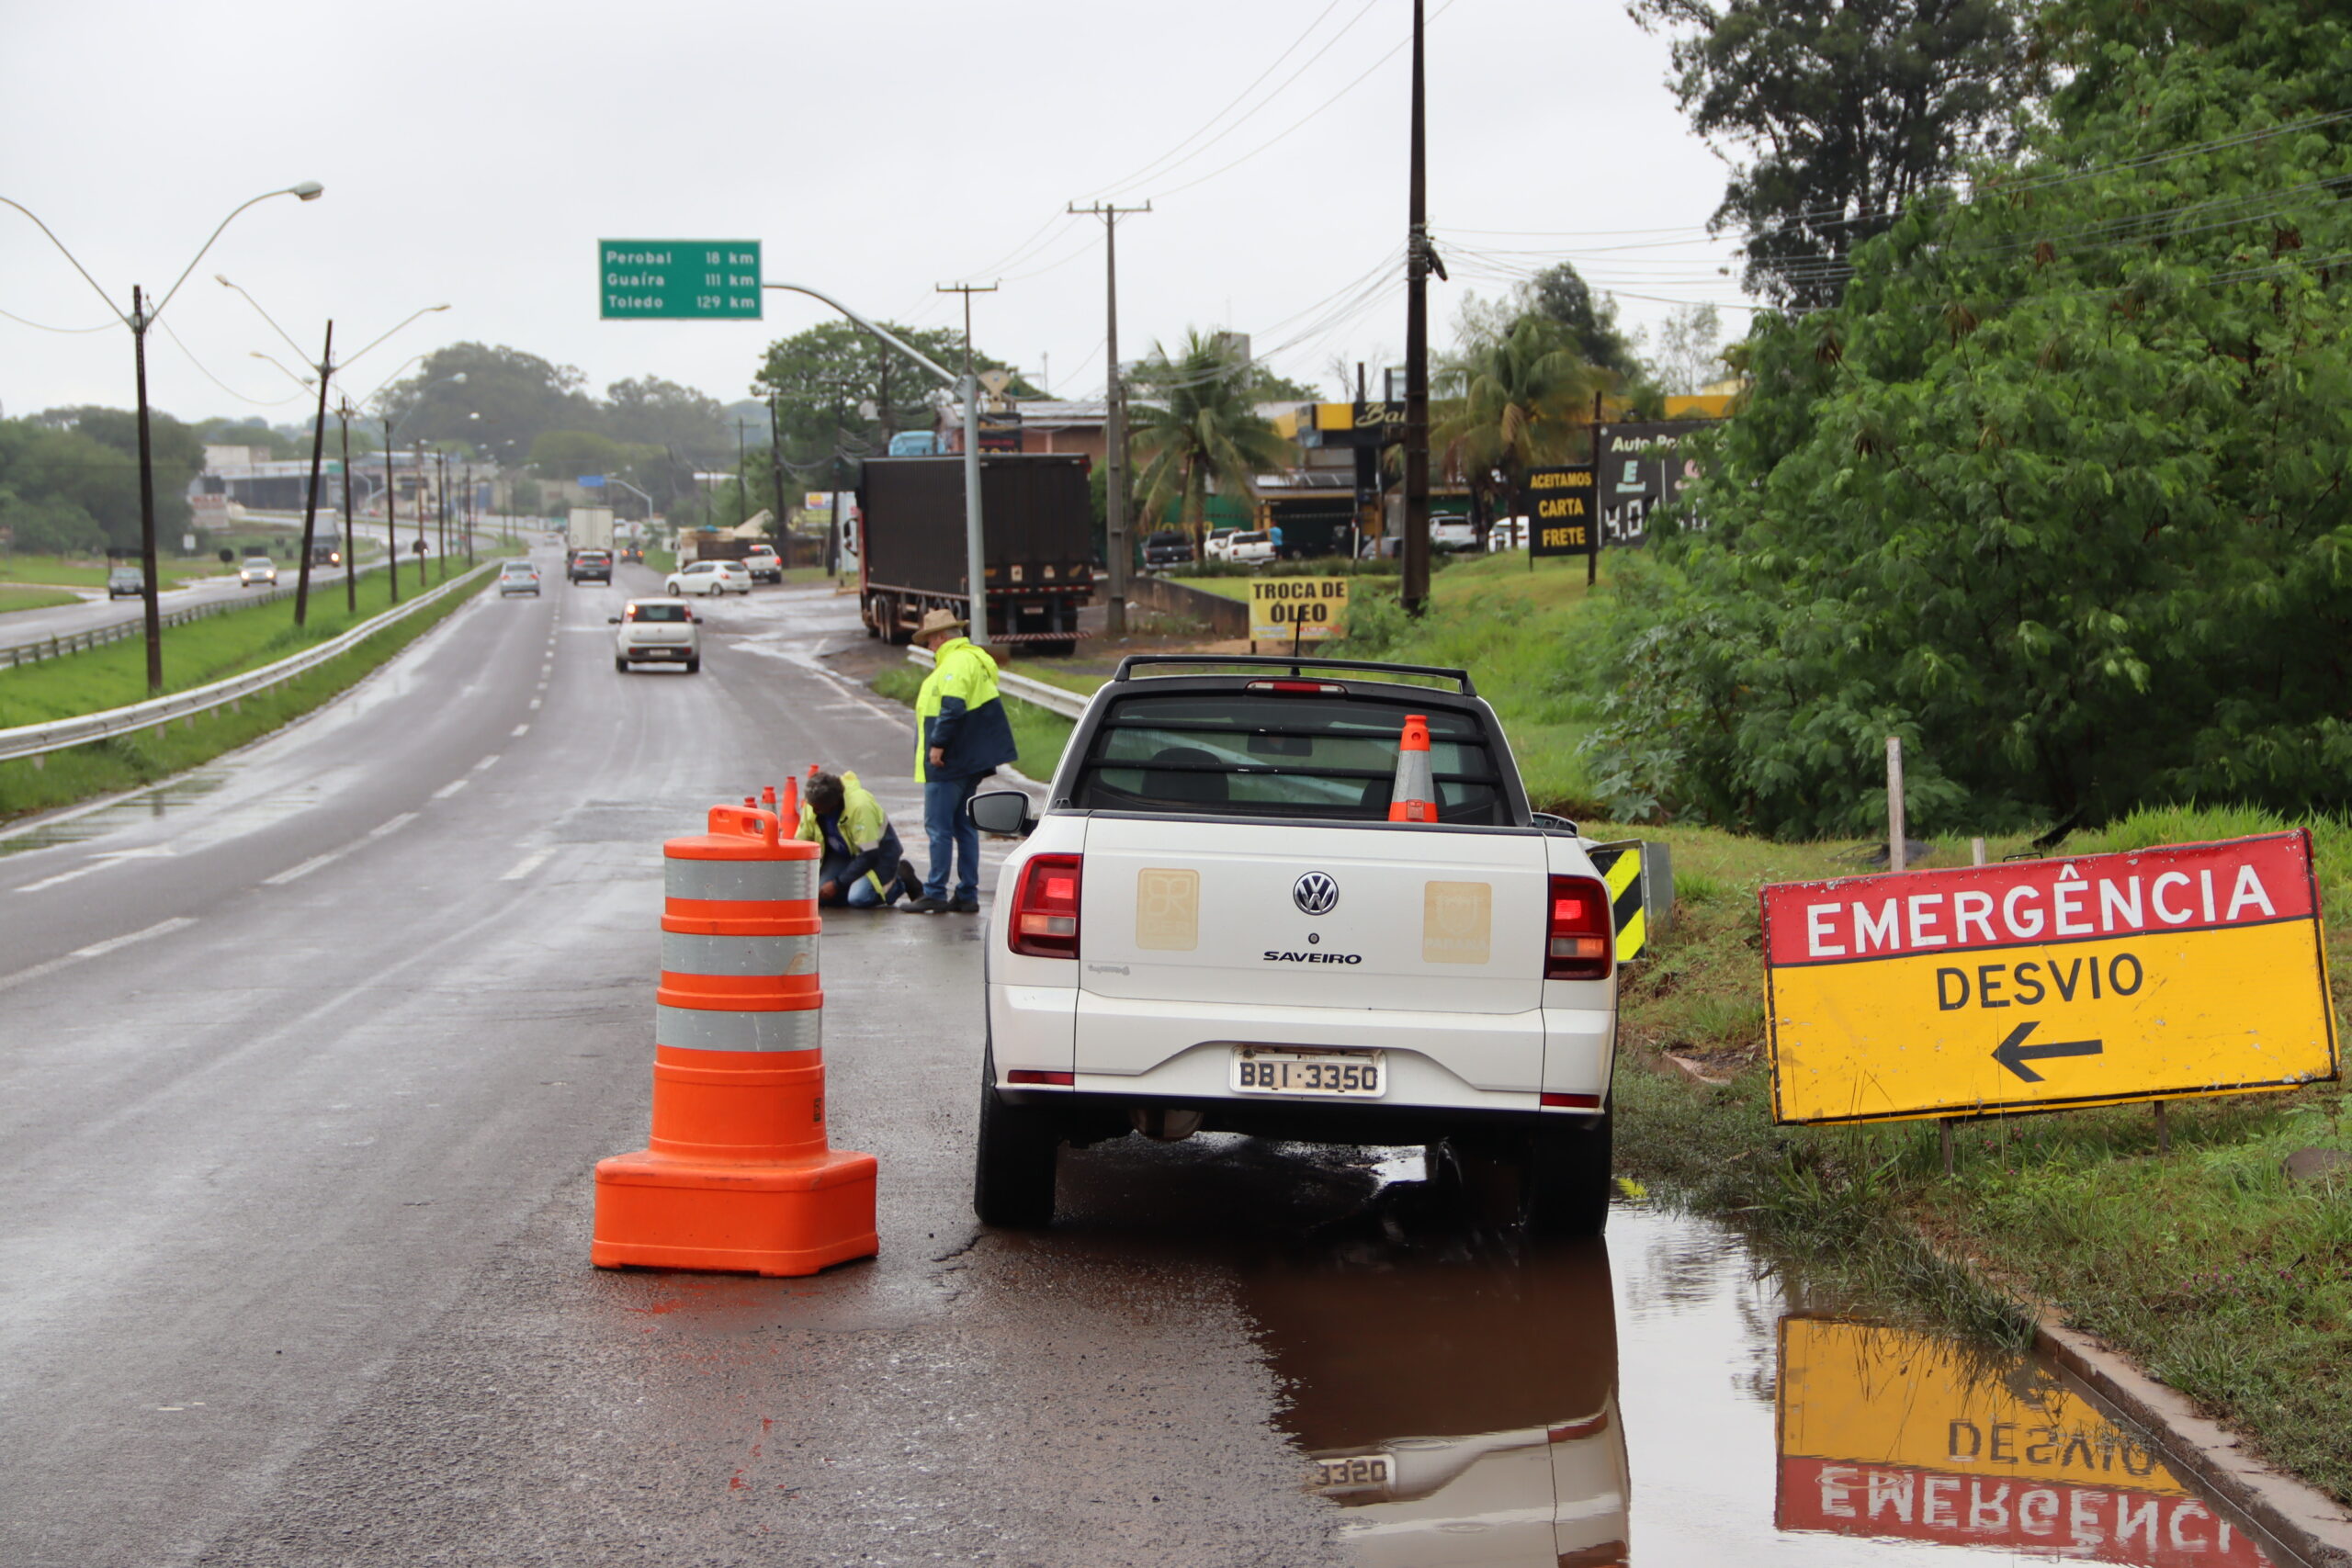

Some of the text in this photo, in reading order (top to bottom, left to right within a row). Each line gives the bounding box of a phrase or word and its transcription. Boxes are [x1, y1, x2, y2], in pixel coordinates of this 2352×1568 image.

[605, 250, 754, 265] Perobal 18 km
[606, 271, 755, 287] Guaíra 111 km
[607, 295, 755, 309] Toledo 129 km
[1611, 436, 1651, 452] Auto
[1531, 471, 1592, 489] ACEITAMOS
[1623, 460, 1638, 482] E
[1539, 498, 1584, 518] CARTA
[1542, 526, 1585, 547] FRETE
[1252, 581, 1345, 600] TROCA DE
[1271, 600, 1328, 623] ÓLEO
[1806, 863, 2276, 957] EMERGÊNCIA
[1263, 951, 1363, 964] SAVEIRO
[1936, 953, 2143, 1011] DESVIO
